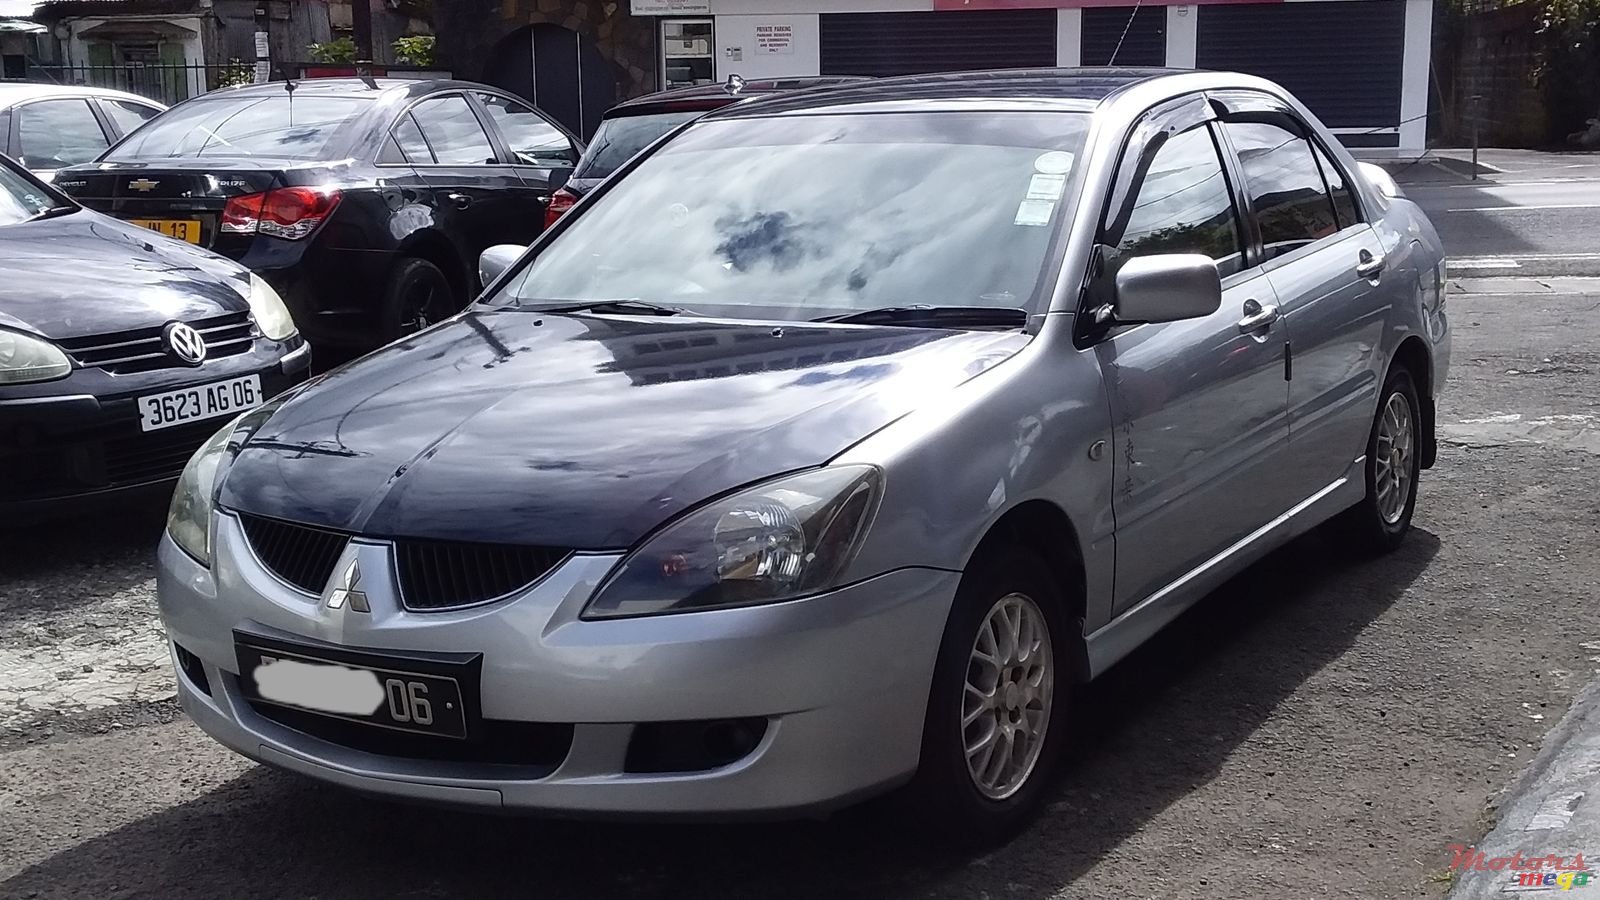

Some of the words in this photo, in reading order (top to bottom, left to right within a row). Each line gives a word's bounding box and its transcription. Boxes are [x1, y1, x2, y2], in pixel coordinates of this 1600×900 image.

[171, 222, 187, 240] 13
[147, 391, 202, 425] 3623
[206, 385, 230, 414] AG
[232, 379, 255, 408] 06
[386, 678, 434, 726] 06
